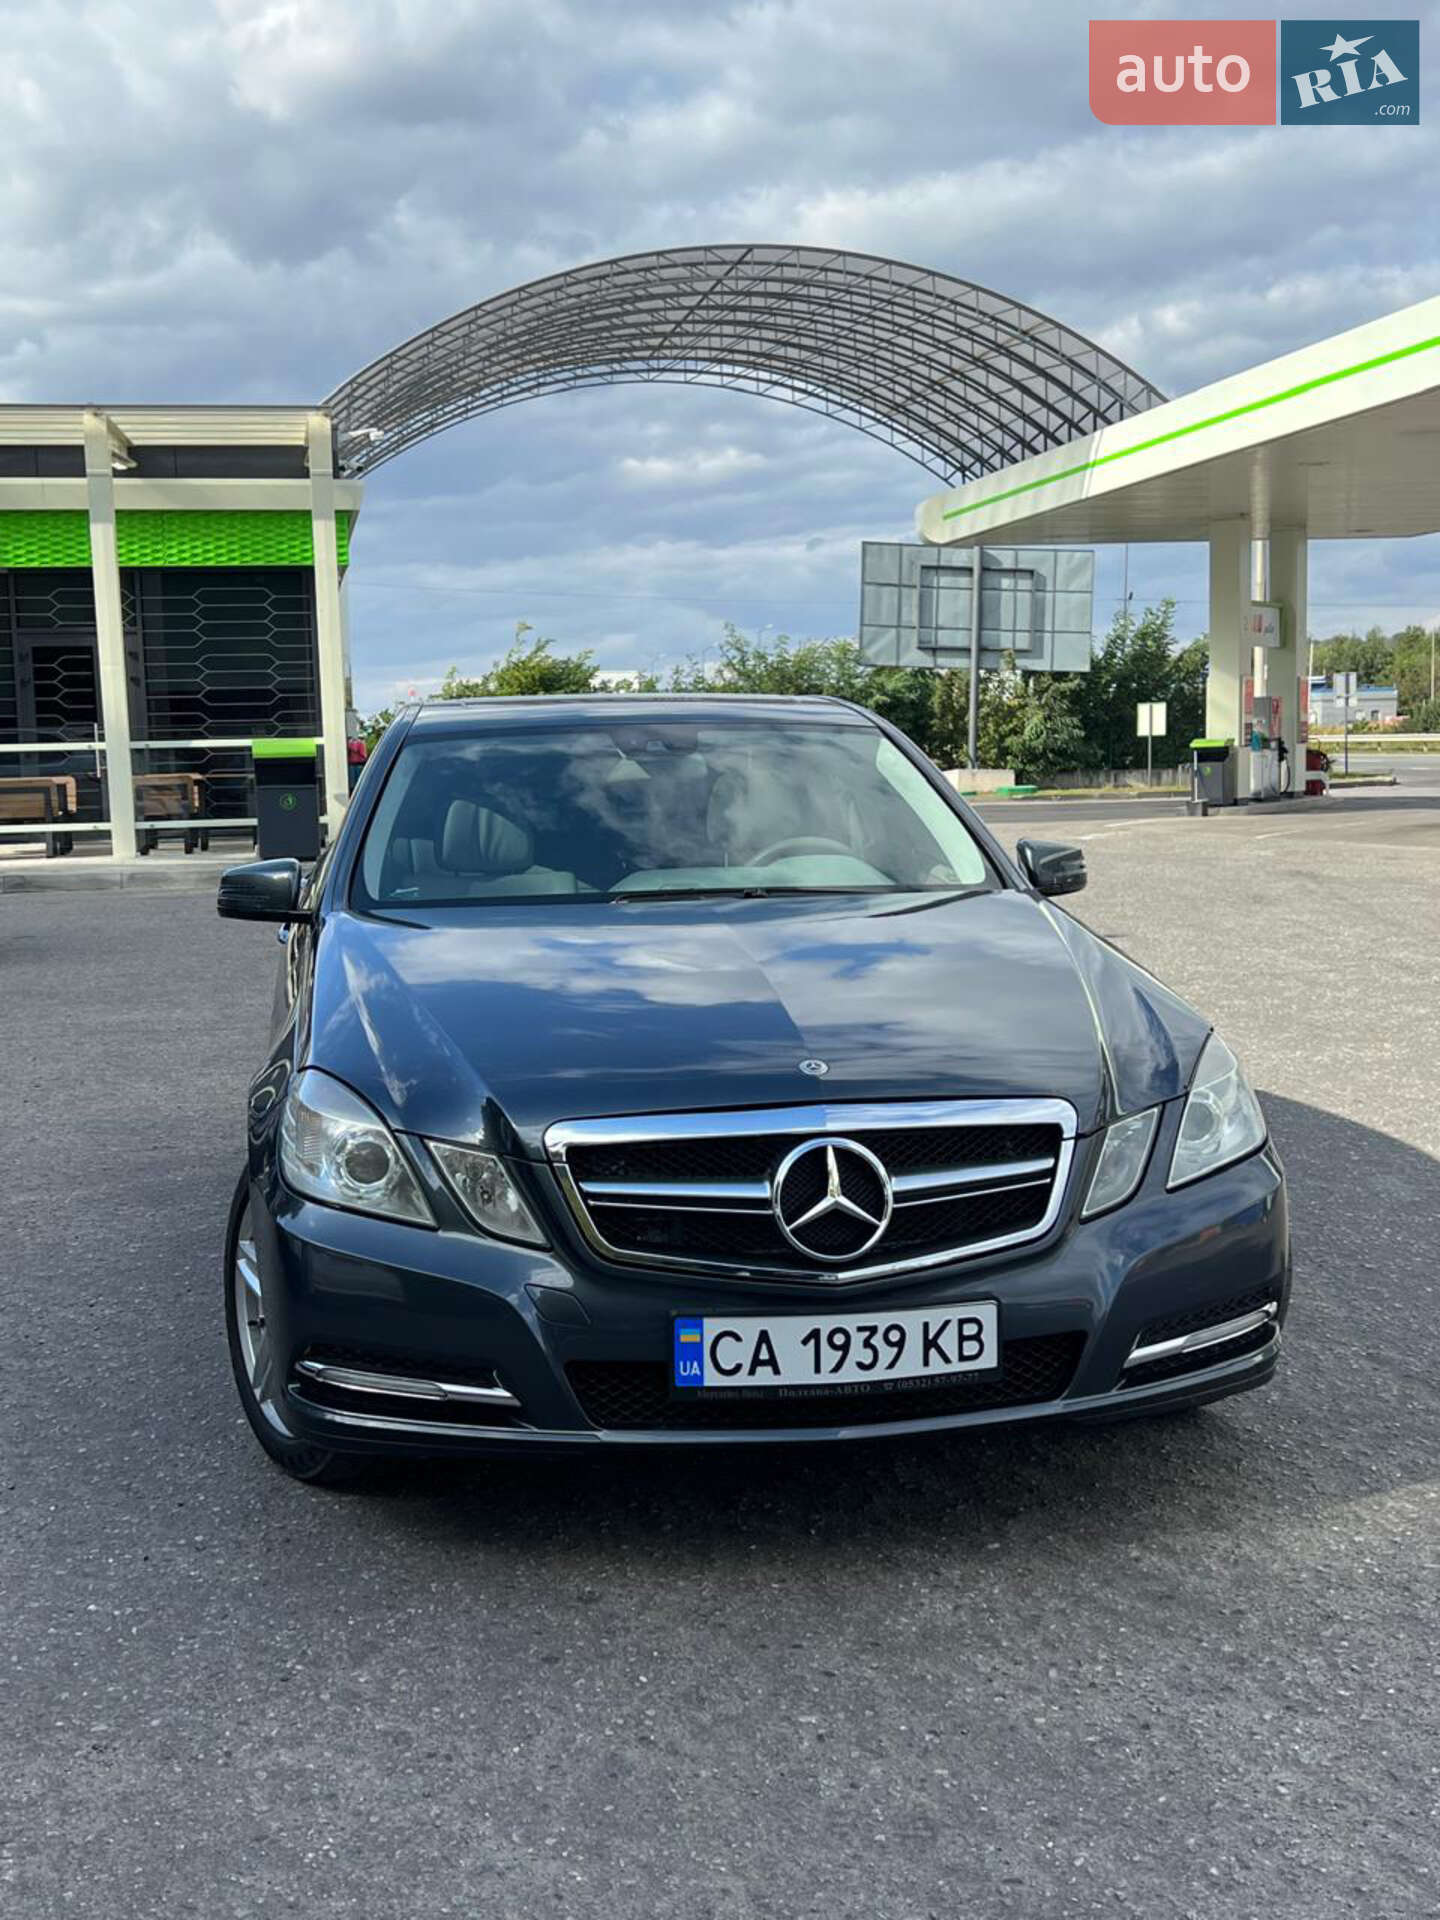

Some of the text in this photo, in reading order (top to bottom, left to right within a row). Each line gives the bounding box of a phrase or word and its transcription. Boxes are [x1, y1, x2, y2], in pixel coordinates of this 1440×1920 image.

[709, 1316, 985, 1377] CA 1939 KB
[679, 1360, 700, 1376] UA
